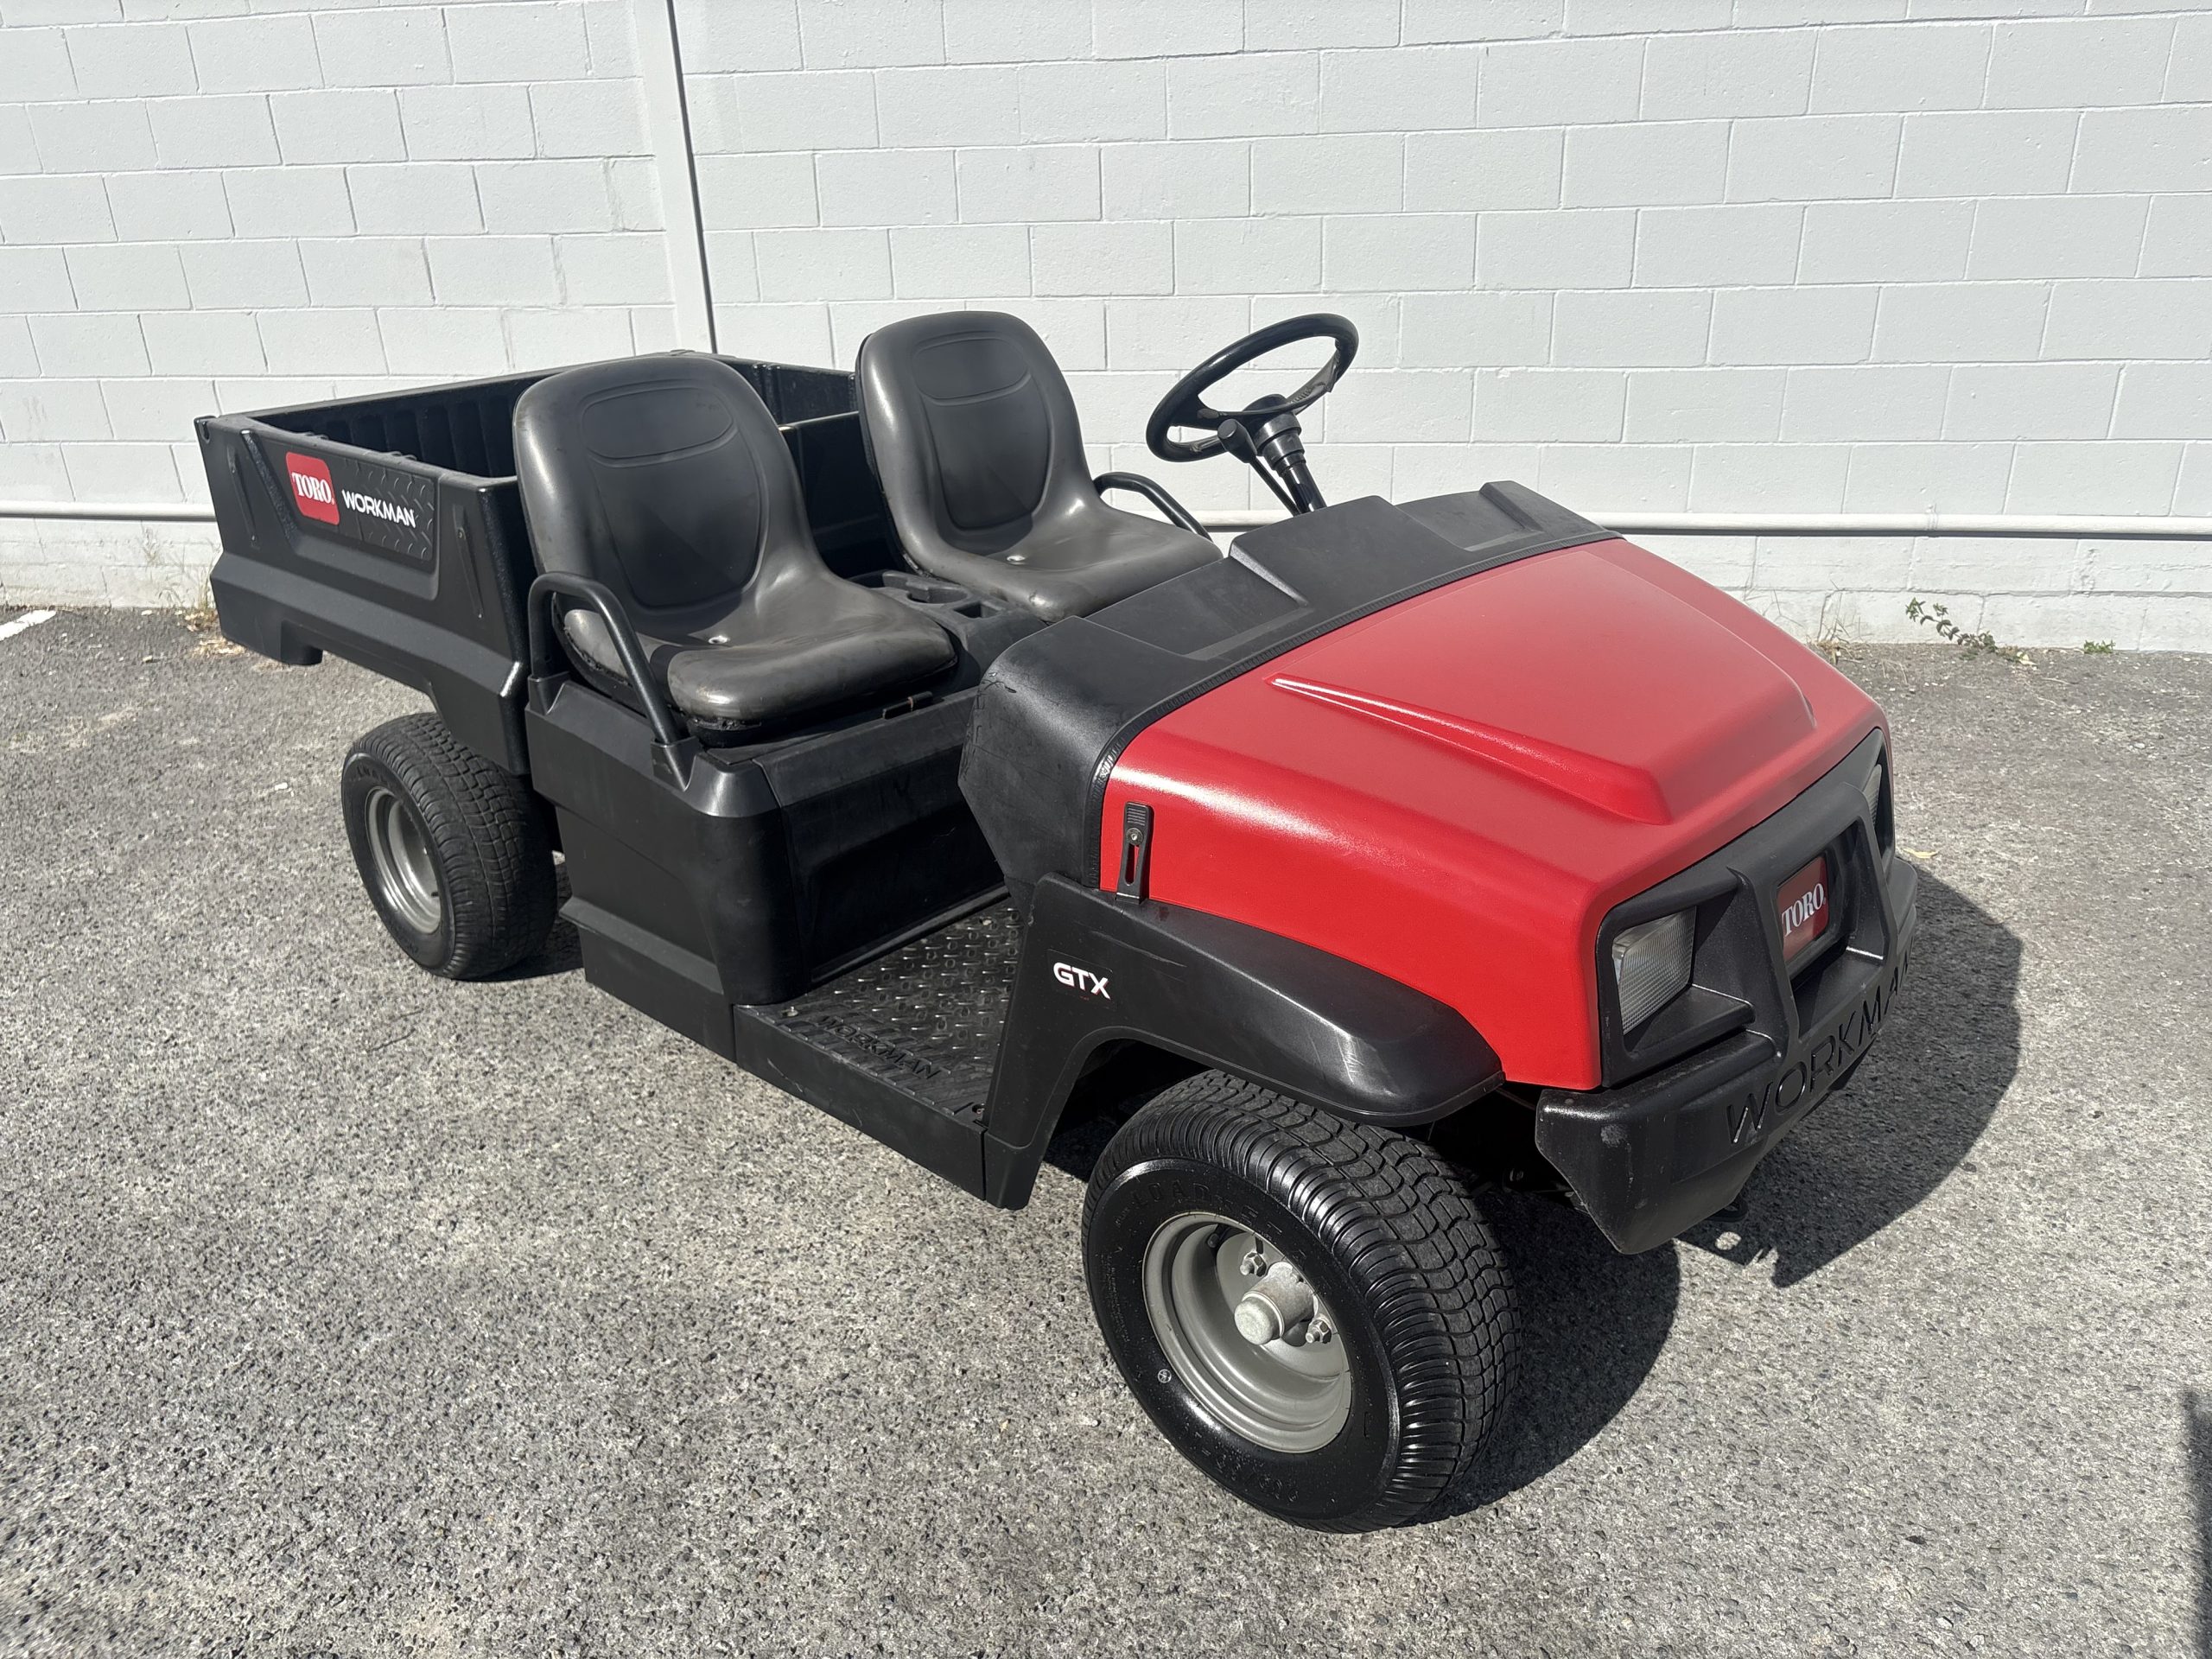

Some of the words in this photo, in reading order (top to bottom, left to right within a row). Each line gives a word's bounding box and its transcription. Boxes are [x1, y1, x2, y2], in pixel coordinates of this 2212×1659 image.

[291, 472, 334, 505] TORO
[341, 489, 416, 529] WORKMAN
[1781, 882, 1825, 938] TORO
[1053, 962, 1111, 1001] GTX
